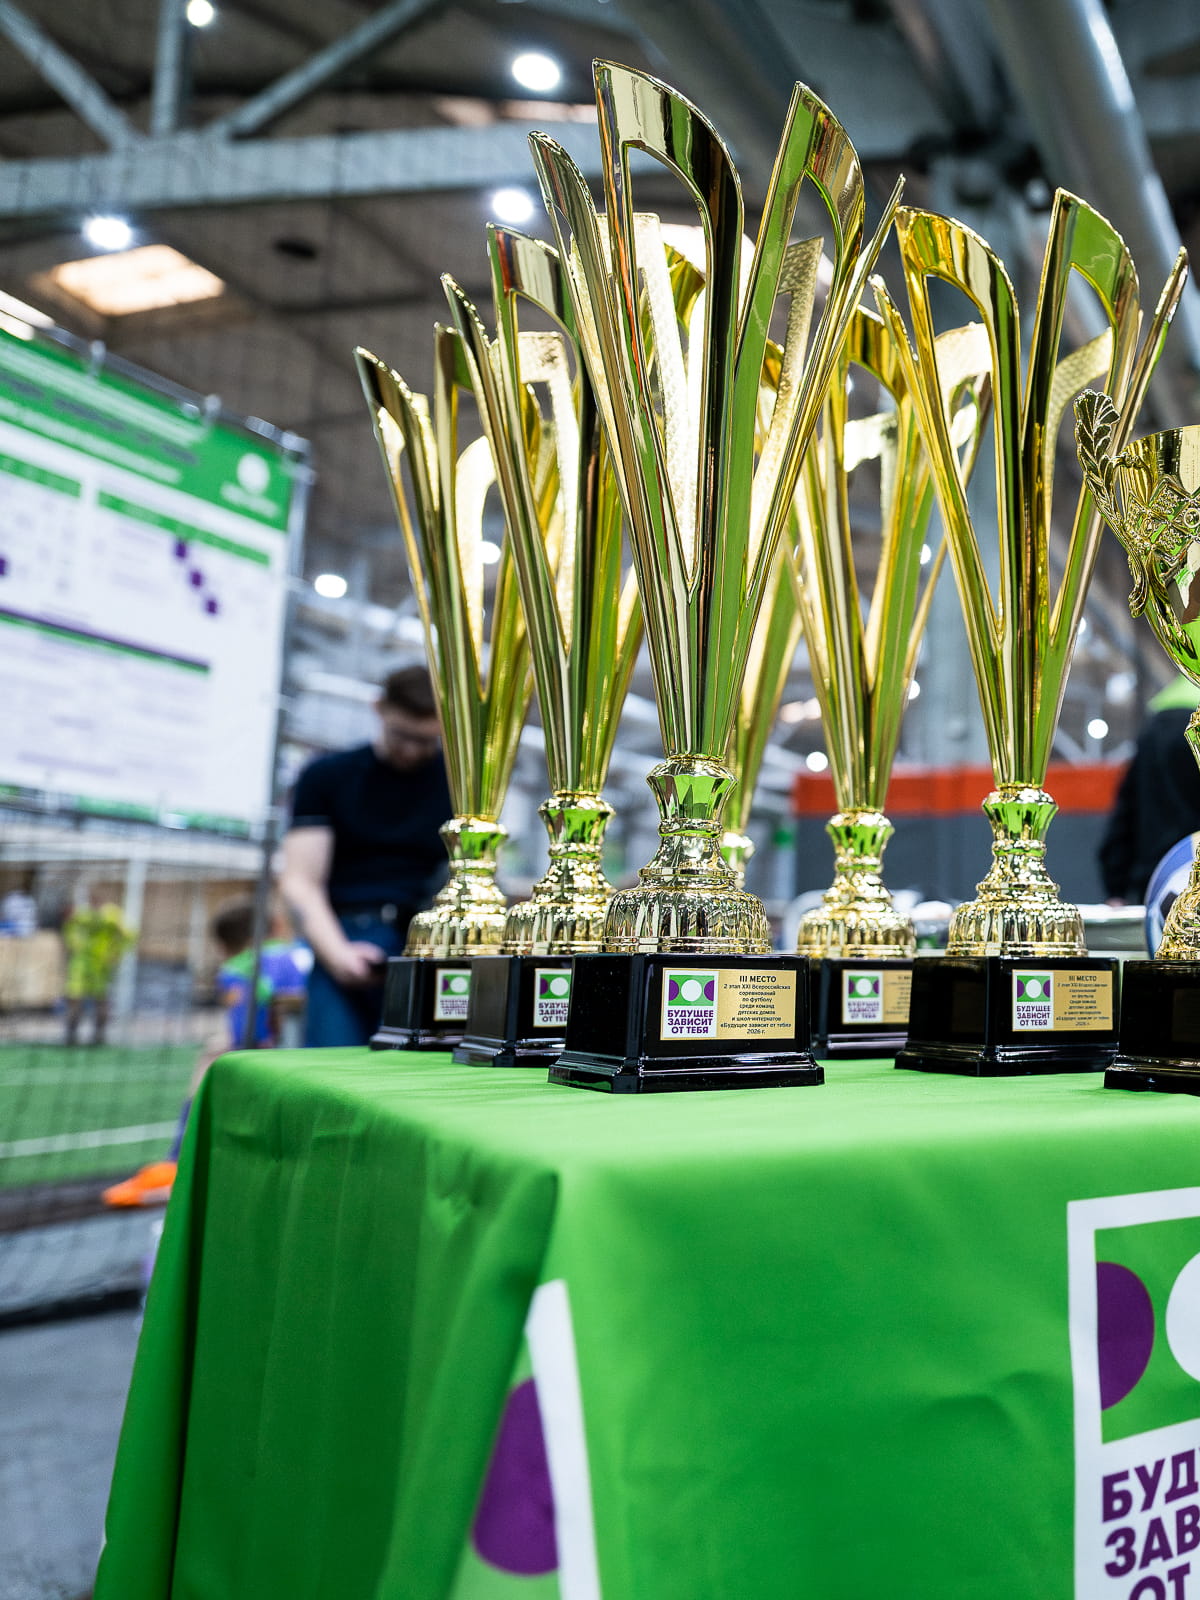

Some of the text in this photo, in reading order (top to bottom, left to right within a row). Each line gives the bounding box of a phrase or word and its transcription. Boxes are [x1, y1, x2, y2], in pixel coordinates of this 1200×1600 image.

[739, 975, 777, 983] III МЕСТО
[667, 1009, 714, 1018] БУДУЩЕЕ
[667, 1018, 713, 1026] ЗАВИСИТ
[671, 1026, 709, 1034] ОТ ТЕБЯ
